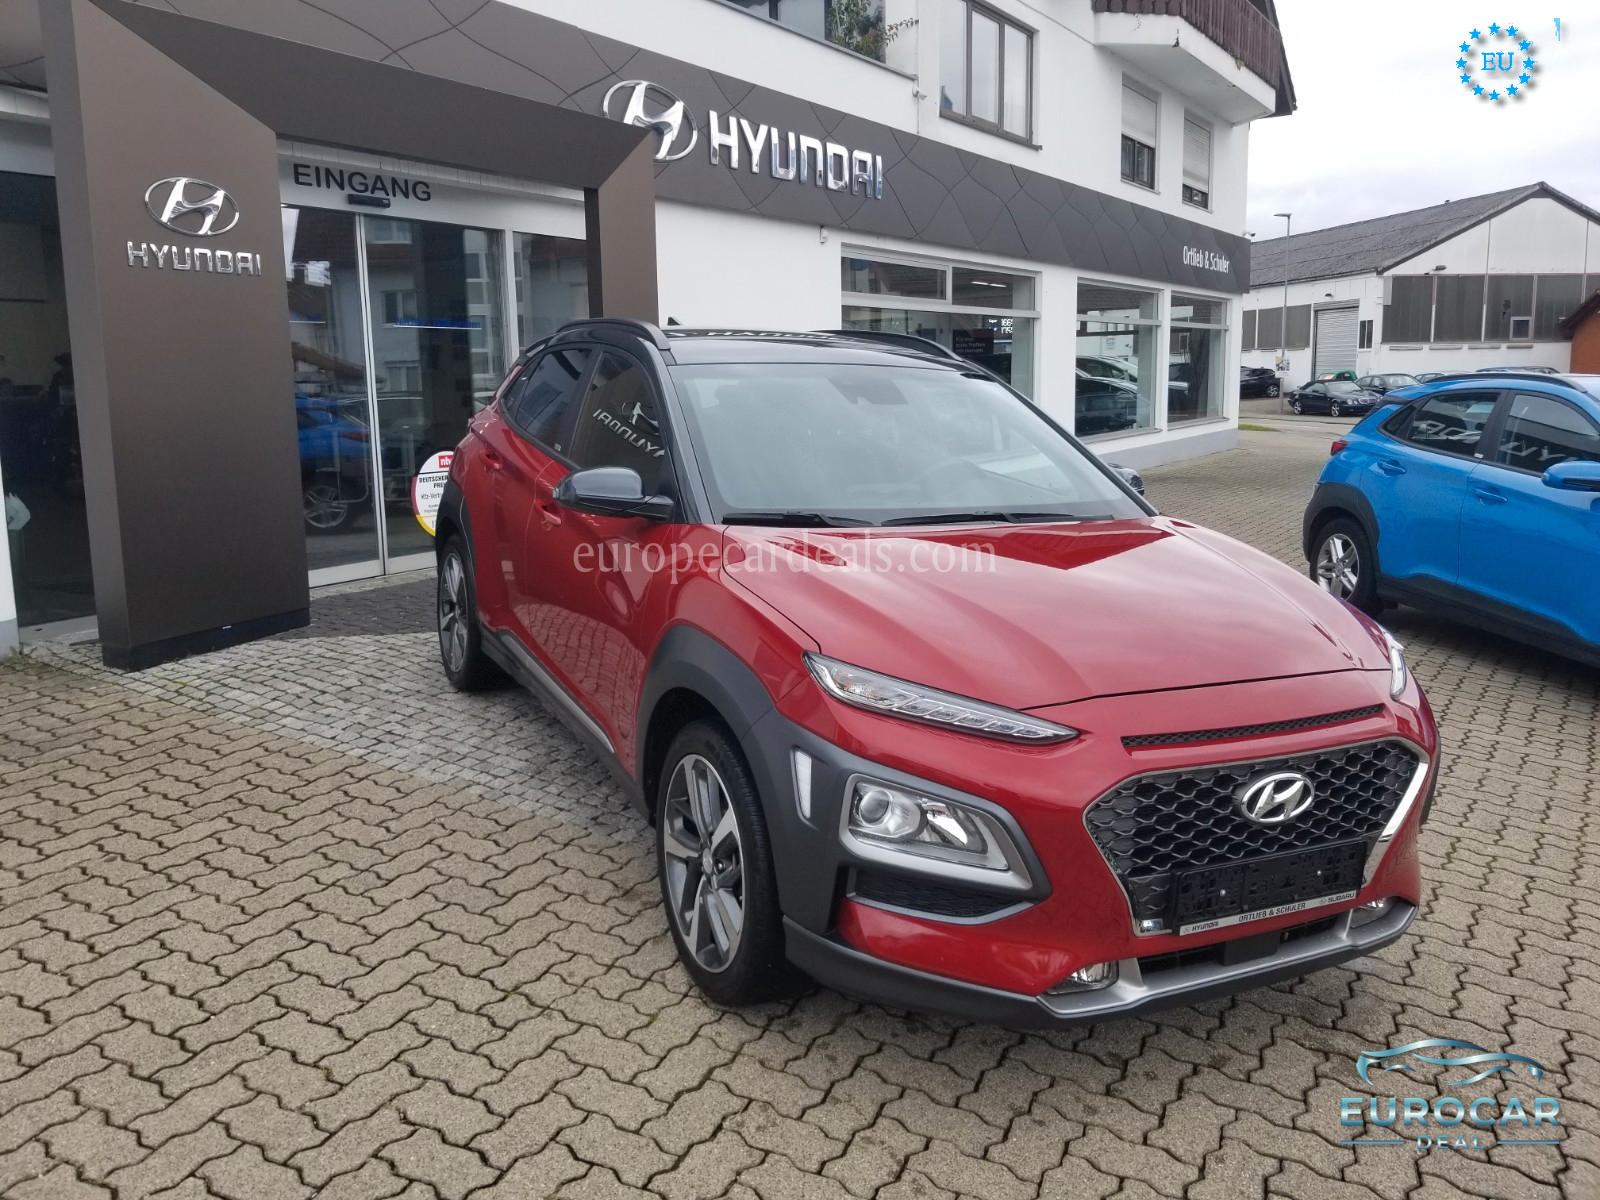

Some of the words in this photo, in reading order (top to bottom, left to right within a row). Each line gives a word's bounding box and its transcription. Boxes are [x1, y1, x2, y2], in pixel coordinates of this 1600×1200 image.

[708, 109, 883, 200] HYUNDAI
[293, 163, 432, 202] EINGANG
[126, 241, 262, 276] HYUNDAI
[1183, 245, 1204, 268] Ortlieb
[1204, 250, 1210, 270] &
[1210, 252, 1230, 274] Schuler
[1191, 920, 1219, 932] HYUNDAI
[1238, 910, 1267, 923] ORTLIEB
[1268, 908, 1275, 918] &
[1275, 902, 1306, 916] SCHULER
[1327, 891, 1356, 904] SUBARU
